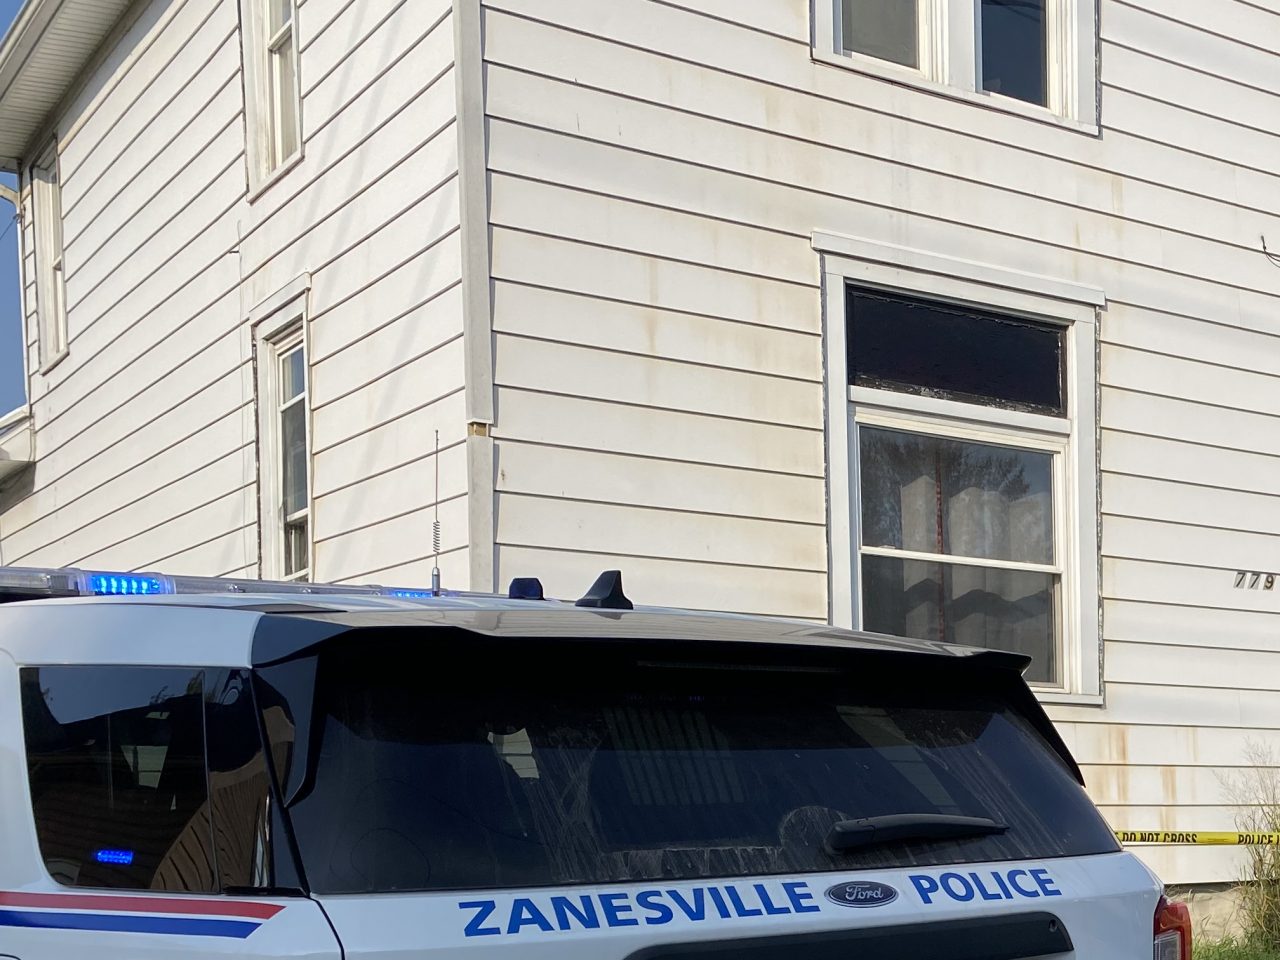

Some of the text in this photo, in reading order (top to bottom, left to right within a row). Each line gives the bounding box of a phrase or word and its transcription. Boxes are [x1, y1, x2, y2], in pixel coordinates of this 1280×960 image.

[1235, 571, 1275, 590] 779
[1122, 832, 1198, 843] DO NOT CROSS
[1237, 833, 1274, 845] POLICE
[845, 884, 884, 900] Ford
[910, 868, 1062, 904] POLICE
[461, 881, 820, 937] ZANESVILLE
